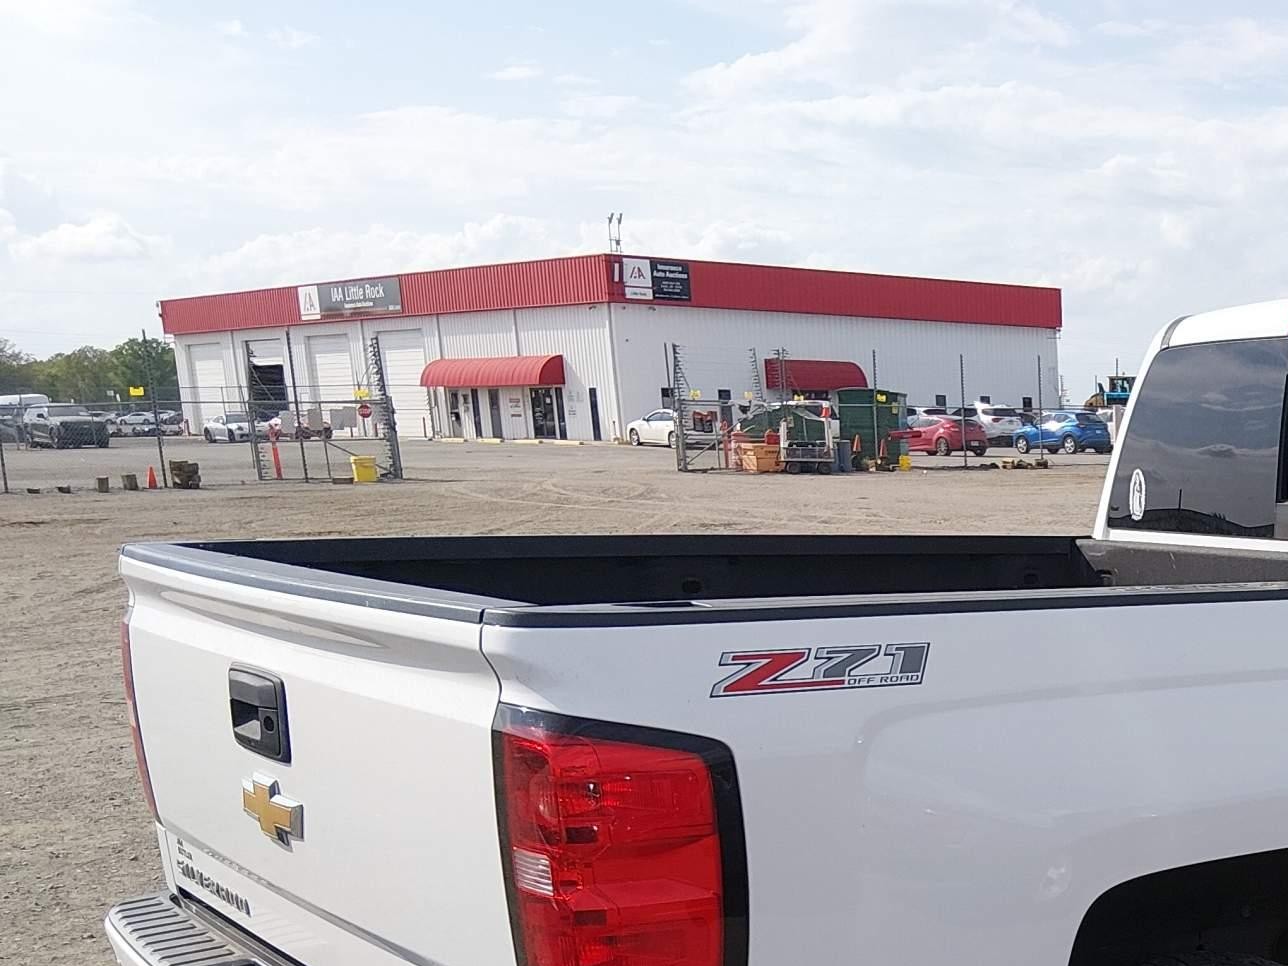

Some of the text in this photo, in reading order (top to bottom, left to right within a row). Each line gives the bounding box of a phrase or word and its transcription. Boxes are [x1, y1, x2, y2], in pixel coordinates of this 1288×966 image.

[331, 287, 344, 302] IAA
[345, 285, 363, 301] Little
[365, 283, 384, 299] Rock
[710, 642, 930, 698] Z71
[847, 673, 919, 686] OFF ROAD
